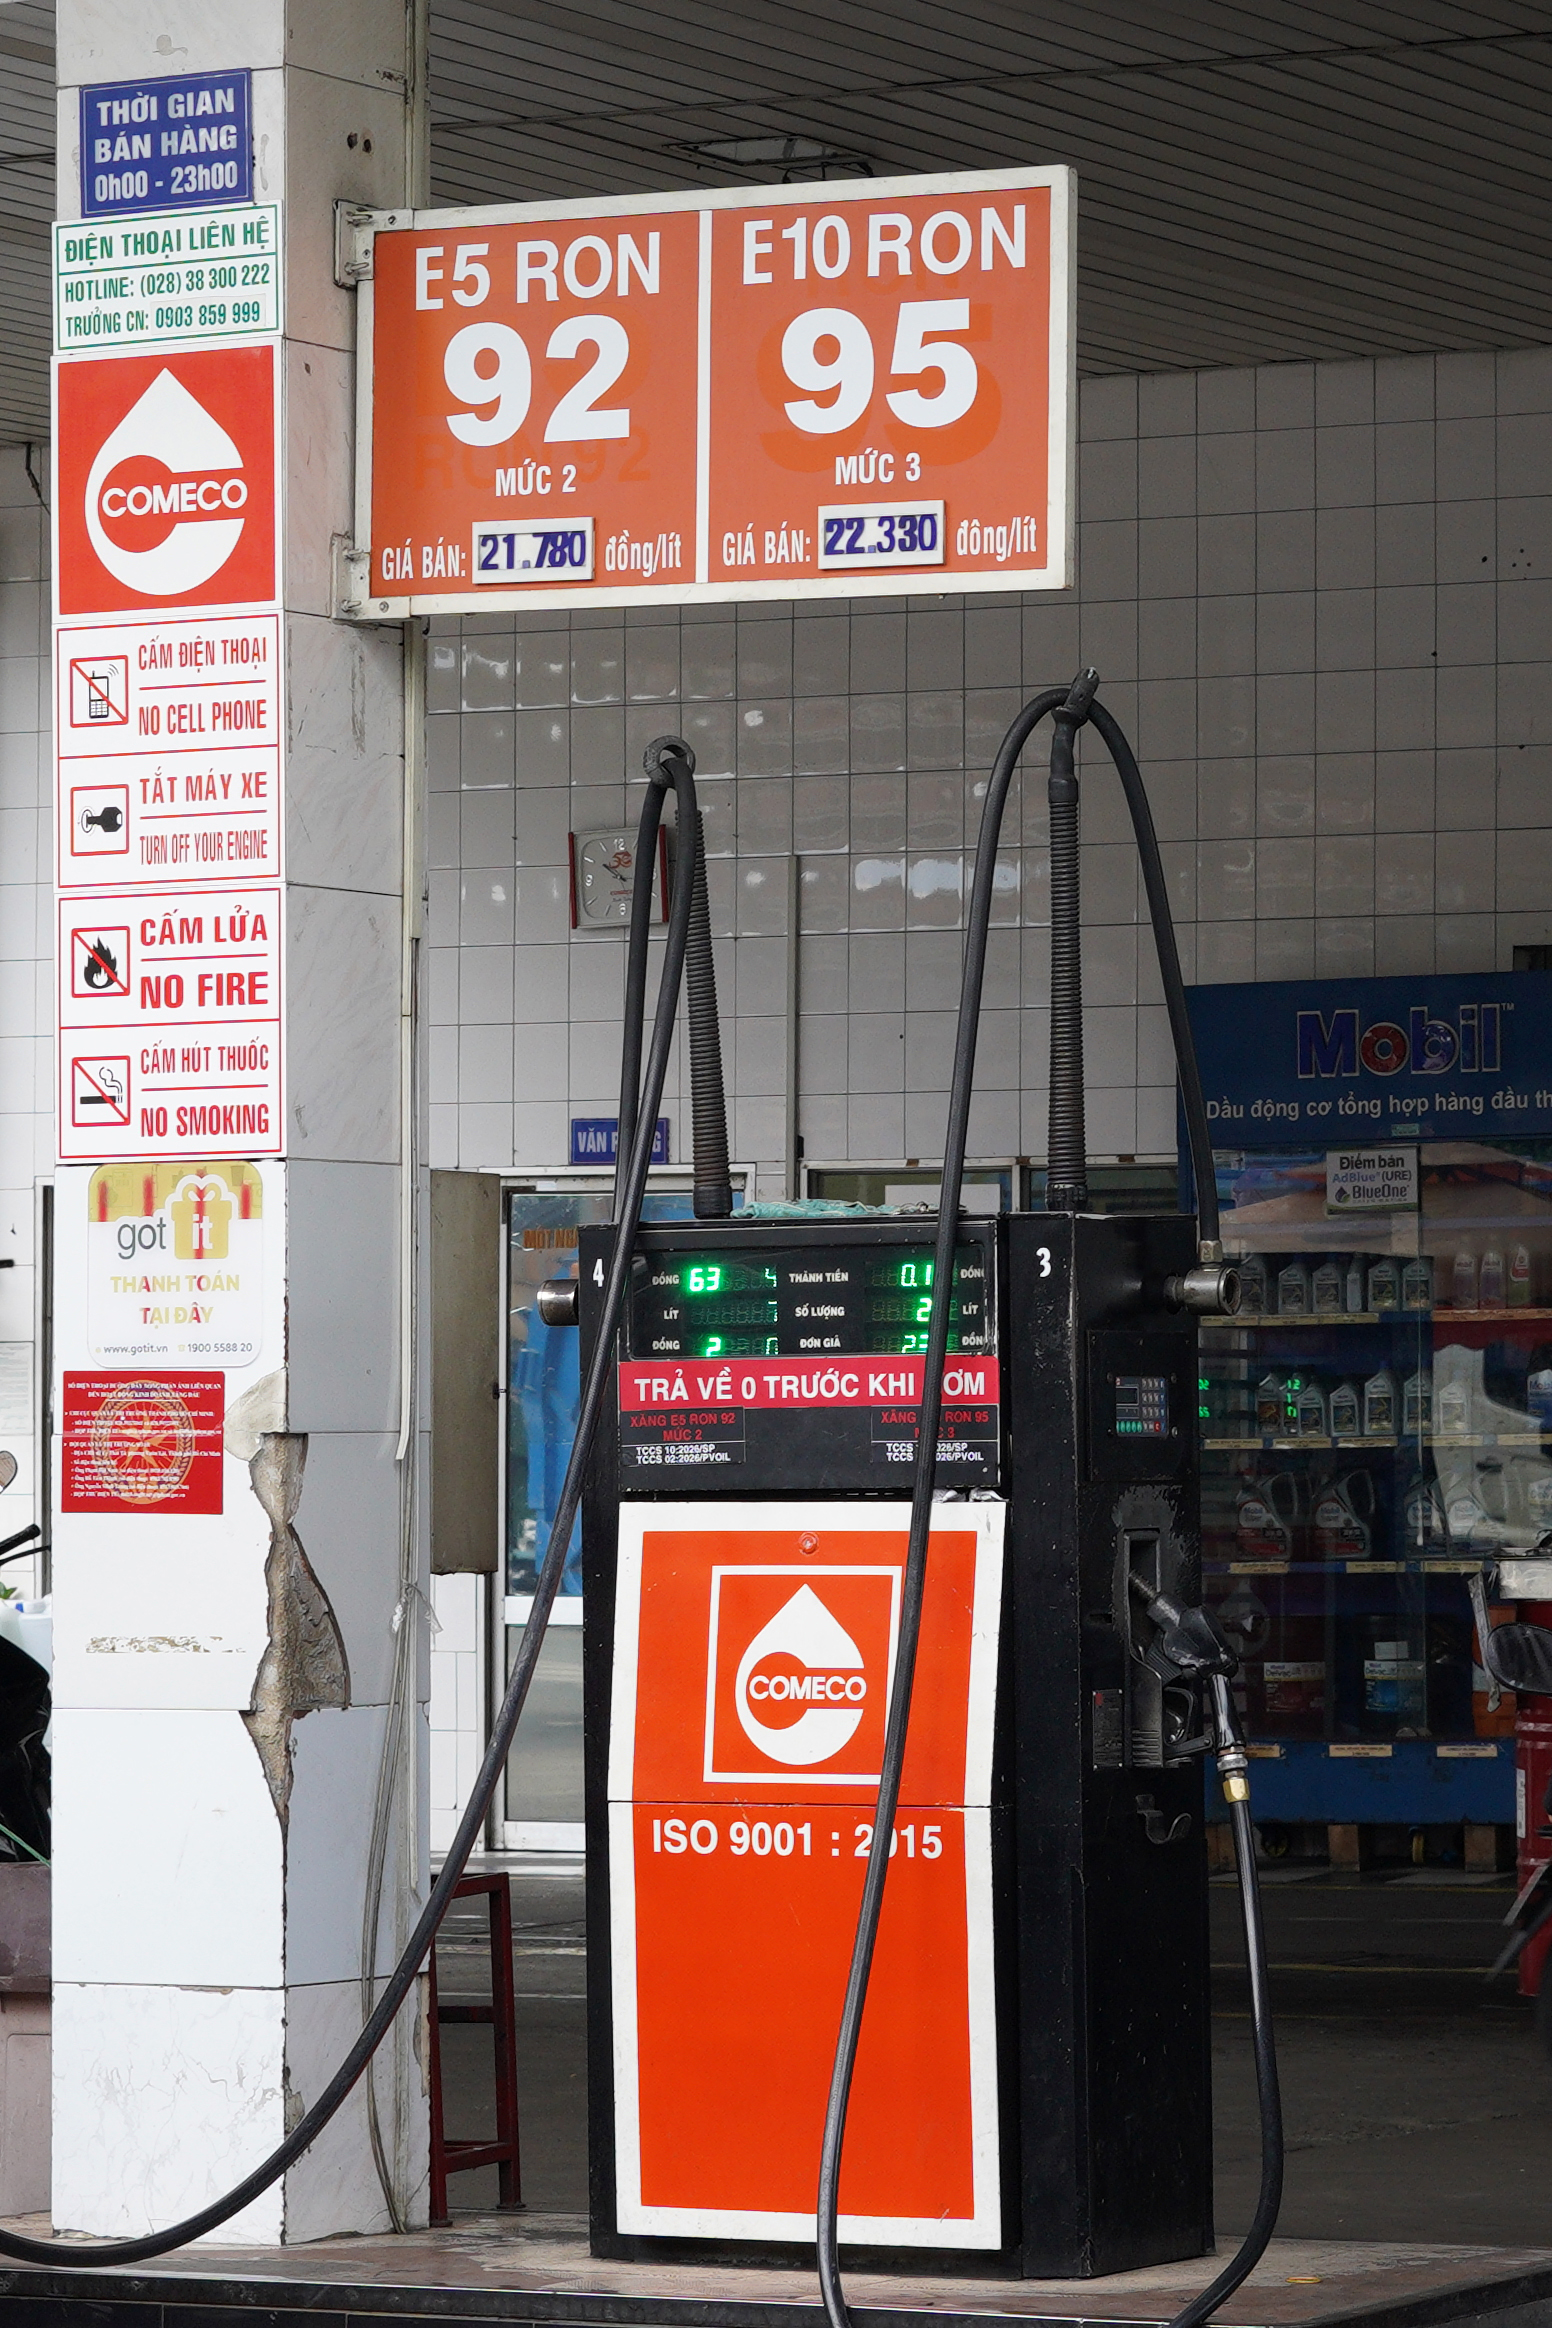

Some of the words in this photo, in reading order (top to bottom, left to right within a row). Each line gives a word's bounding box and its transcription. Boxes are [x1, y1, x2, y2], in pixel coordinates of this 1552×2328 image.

[96, 91, 158, 127] THỜI
[167, 87, 235, 119] GIAN
[94, 130, 151, 164] BÁN
[160, 123, 238, 157] HÀNG
[94, 169, 148, 202] 0h00
[170, 160, 238, 195] 23h00
[64, 232, 113, 267] ĐIỆN
[121, 229, 182, 259] THOẠI
[189, 220, 236, 251] LIÊN
[242, 215, 270, 250] HỆ
[742, 213, 851, 286] E10
[868, 204, 1027, 277] RON
[64, 276, 134, 304] HOTLINE:
[140, 270, 182, 297] (028)
[185, 269, 204, 292] 38
[208, 265, 237, 290] 300
[241, 262, 270, 287] 222
[415, 242, 491, 311] E5
[516, 231, 660, 305] RON
[65, 306, 121, 337] TRƯỞNG
[126, 310, 149, 333] CN:
[155, 305, 193, 329] 0903
[198, 302, 227, 326] 859
[232, 300, 261, 324] 999
[443, 314, 630, 448] 92
[781, 297, 978, 436] 95
[495, 458, 551, 497] MỨC
[562, 464, 577, 493] 2
[835, 448, 894, 485] MỨC
[905, 452, 921, 482] 3
[101, 477, 248, 518] COMECO
[381, 536, 414, 581] GIÁ
[421, 536, 466, 579] BÁN:
[480, 531, 587, 570] 21.780
[605, 529, 682, 578] đồng/lít
[722, 522, 756, 566] GIÁ
[764, 520, 811, 564] BÁN:
[824, 514, 938, 556] 22.330
[138, 635, 173, 671] CẤM
[178, 635, 215, 673] ĐIỆN
[221, 636, 267, 670] THOẠI
[138, 705, 160, 736] NO
[167, 702, 205, 734] CELL
[212, 699, 267, 731] PHONE
[140, 766, 178, 804] TẮT
[185, 768, 233, 802] MÁY
[241, 771, 267, 799] XE
[139, 834, 168, 865] TURN
[171, 833, 190, 864] OFF
[194, 831, 224, 862] YOUR
[227, 829, 268, 860] ENGINE
[140, 908, 203, 946] CẤM
[214, 905, 268, 943] LỬA
[140, 974, 184, 1009] NO
[198, 971, 268, 1007] FIRE
[141, 1040, 176, 1075] CẤM
[181, 1040, 211, 1073] HÚT
[217, 1036, 269, 1072] THUỐC
[1297, 1003, 1501, 1078] Mobil
[141, 1106, 168, 1137] NO
[176, 1103, 269, 1137] SMOKING
[1206, 1095, 1244, 1120] Dầu
[1251, 1098, 1300, 1122] động
[1306, 1100, 1332, 1116] cơ
[1338, 1091, 1381, 1119] tổng
[1389, 1095, 1429, 1117] hợp
[1435, 1091, 1484, 1115] hàng
[1491, 1085, 1529, 1110] đầu
[577, 1126, 607, 1153] VĂN
[117, 1216, 167, 1260] got
[192, 1213, 213, 1250] it
[110, 1276, 181, 1293] THANH
[185, 1269, 240, 1292] TOÁN
[593, 1258, 604, 1287] 4
[1035, 1247, 1051, 1278] 3
[139, 1307, 170, 1330] TẠI
[173, 1301, 213, 1324] ĐÂY
[103, 1342, 168, 1356] www.gotit.vn
[187, 1343, 211, 1352] 1900
[214, 1342, 238, 1352] 5588
[240, 1343, 252, 1352] 20
[633, 1369, 689, 1402] TRẢ
[696, 1366, 733, 1400] VỀ
[741, 1376, 757, 1400] 0
[763, 1368, 860, 1399] TRƯỚC
[868, 1373, 915, 1397] KHI
[629, 1414, 667, 1427] XĂNG
[670, 1414, 686, 1426] E5
[689, 1413, 717, 1425] RON
[720, 1412, 736, 1424] 92
[662, 1428, 692, 1441] MỨC
[695, 1429, 702, 1441] 2
[945, 1411, 972, 1423] RON
[974, 1411, 989, 1423] 95
[947, 1427, 955, 1438] 3
[636, 1446, 662, 1456] TCCS
[636, 1455, 662, 1465] TCCS
[886, 1443, 914, 1452] TCCS
[886, 1452, 914, 1461] TCCS
[749, 1674, 867, 1701] COMECO
[652, 1819, 718, 1855] ISO
[730, 1821, 811, 1857] 9001
